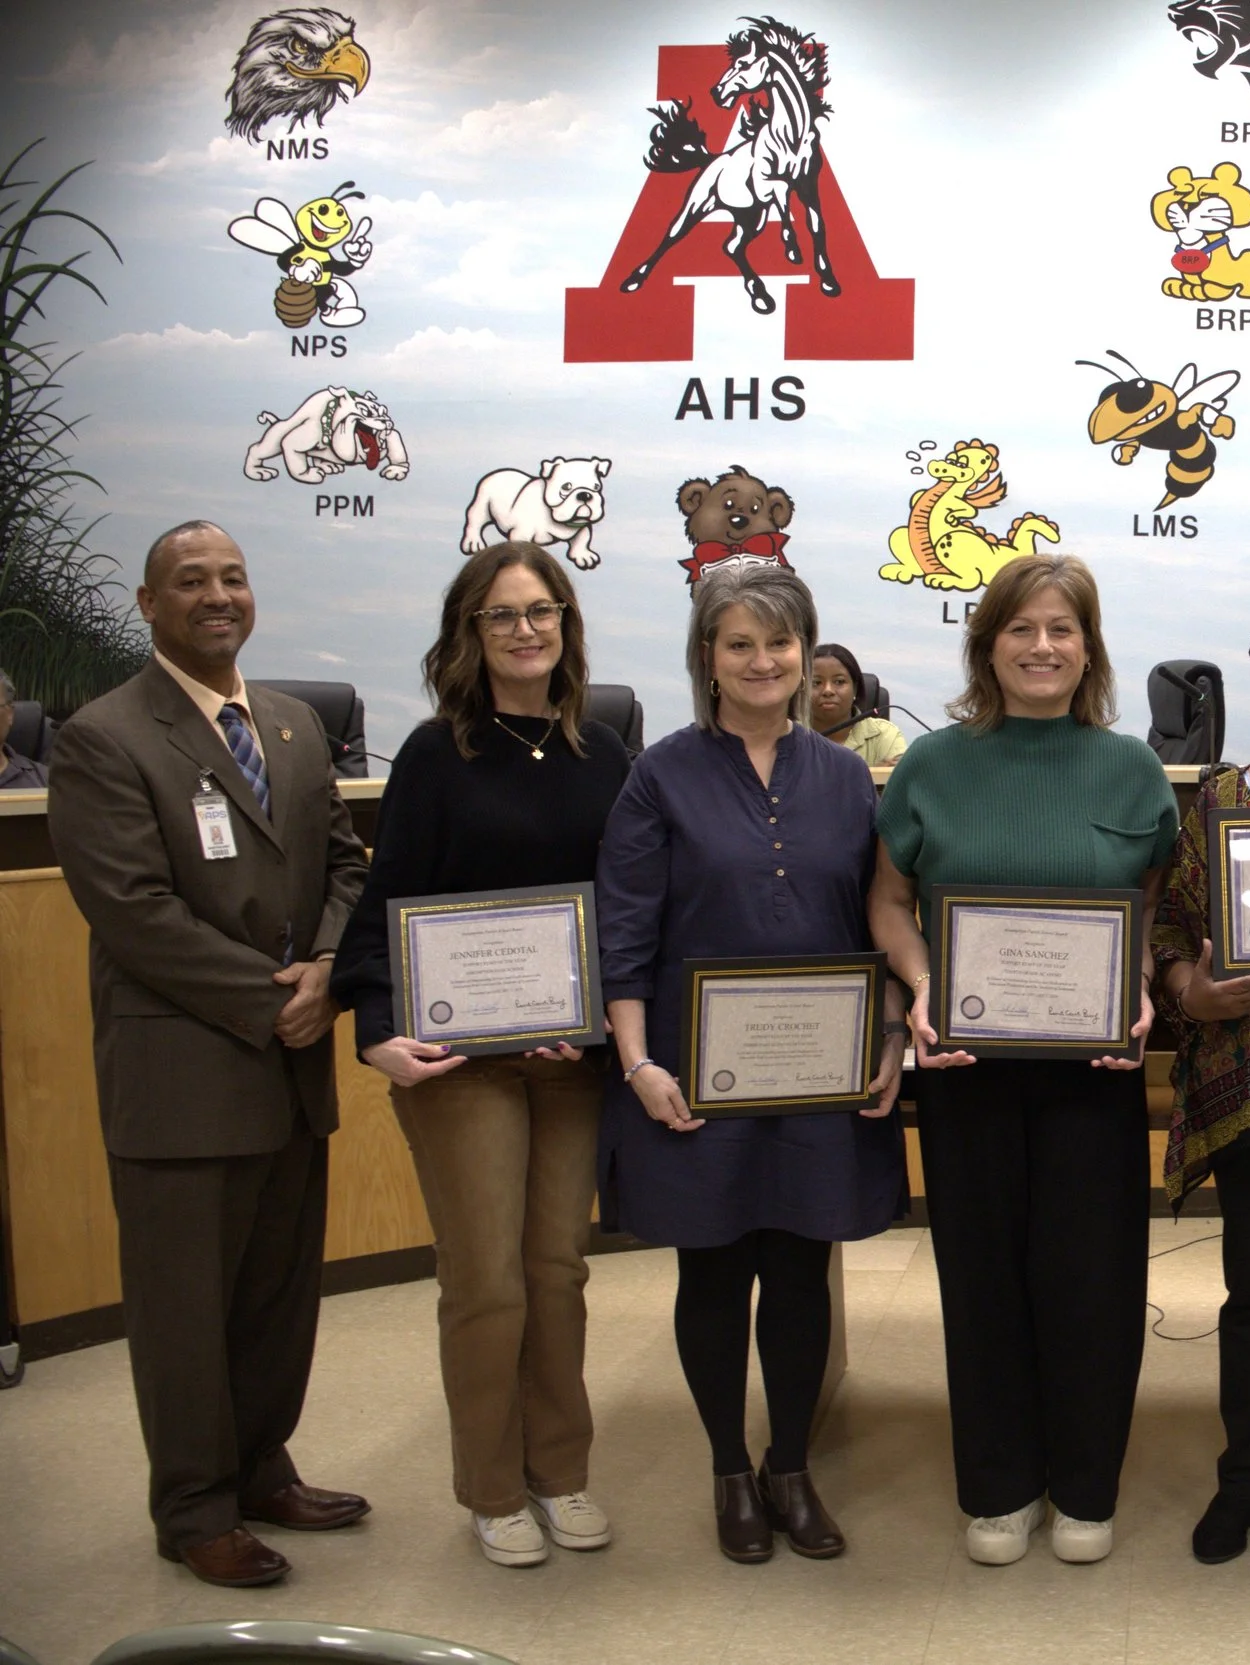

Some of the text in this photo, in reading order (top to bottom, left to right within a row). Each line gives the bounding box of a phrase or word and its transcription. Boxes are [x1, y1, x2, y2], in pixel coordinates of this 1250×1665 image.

[266, 137, 329, 160] NMS
[1181, 255, 1200, 264] BRP
[291, 334, 348, 357] NPS
[674, 375, 806, 421] AHS
[315, 494, 374, 516] PPM
[1133, 513, 1199, 538] LMS
[449, 945, 539, 961] JENNIFER CEDOTAL
[999, 948, 1070, 961] GINA SANCHEZ
[744, 1022, 822, 1032] TRUDY CROCHET
